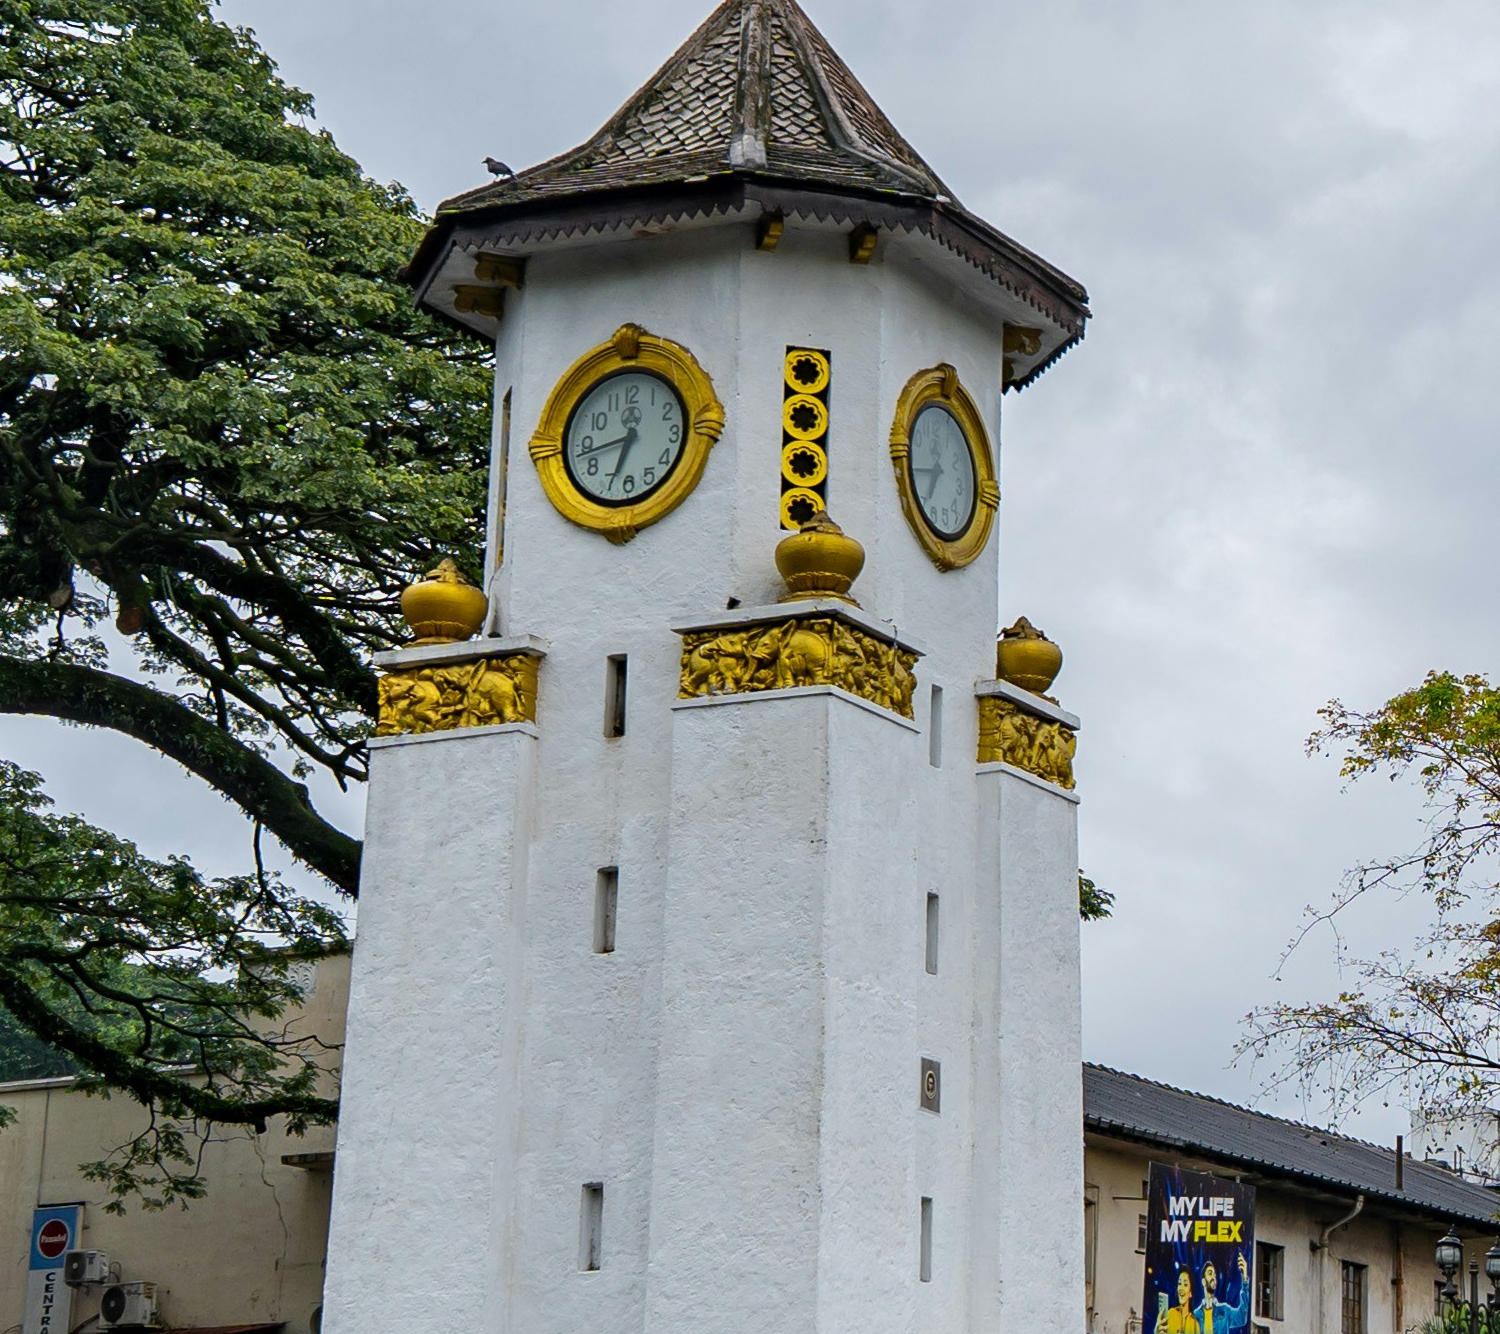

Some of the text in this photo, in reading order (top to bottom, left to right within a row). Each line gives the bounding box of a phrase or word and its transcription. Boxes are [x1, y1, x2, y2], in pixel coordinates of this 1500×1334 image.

[608, 393, 619, 412] 11
[625, 385, 639, 405] 12
[662, 402, 673, 421] 2
[591, 412, 608, 431] 10
[668, 424, 680, 443] 3
[581, 436, 594, 453] 9
[587, 457, 599, 476] 8
[658, 448, 670, 466] 4
[605, 473, 617, 491] 7
[623, 475, 635, 493] 6
[643, 467, 655, 486] 5
[1169, 1196, 1234, 1217] MY LIFE
[1161, 1220, 1243, 1242] MY FLEX
